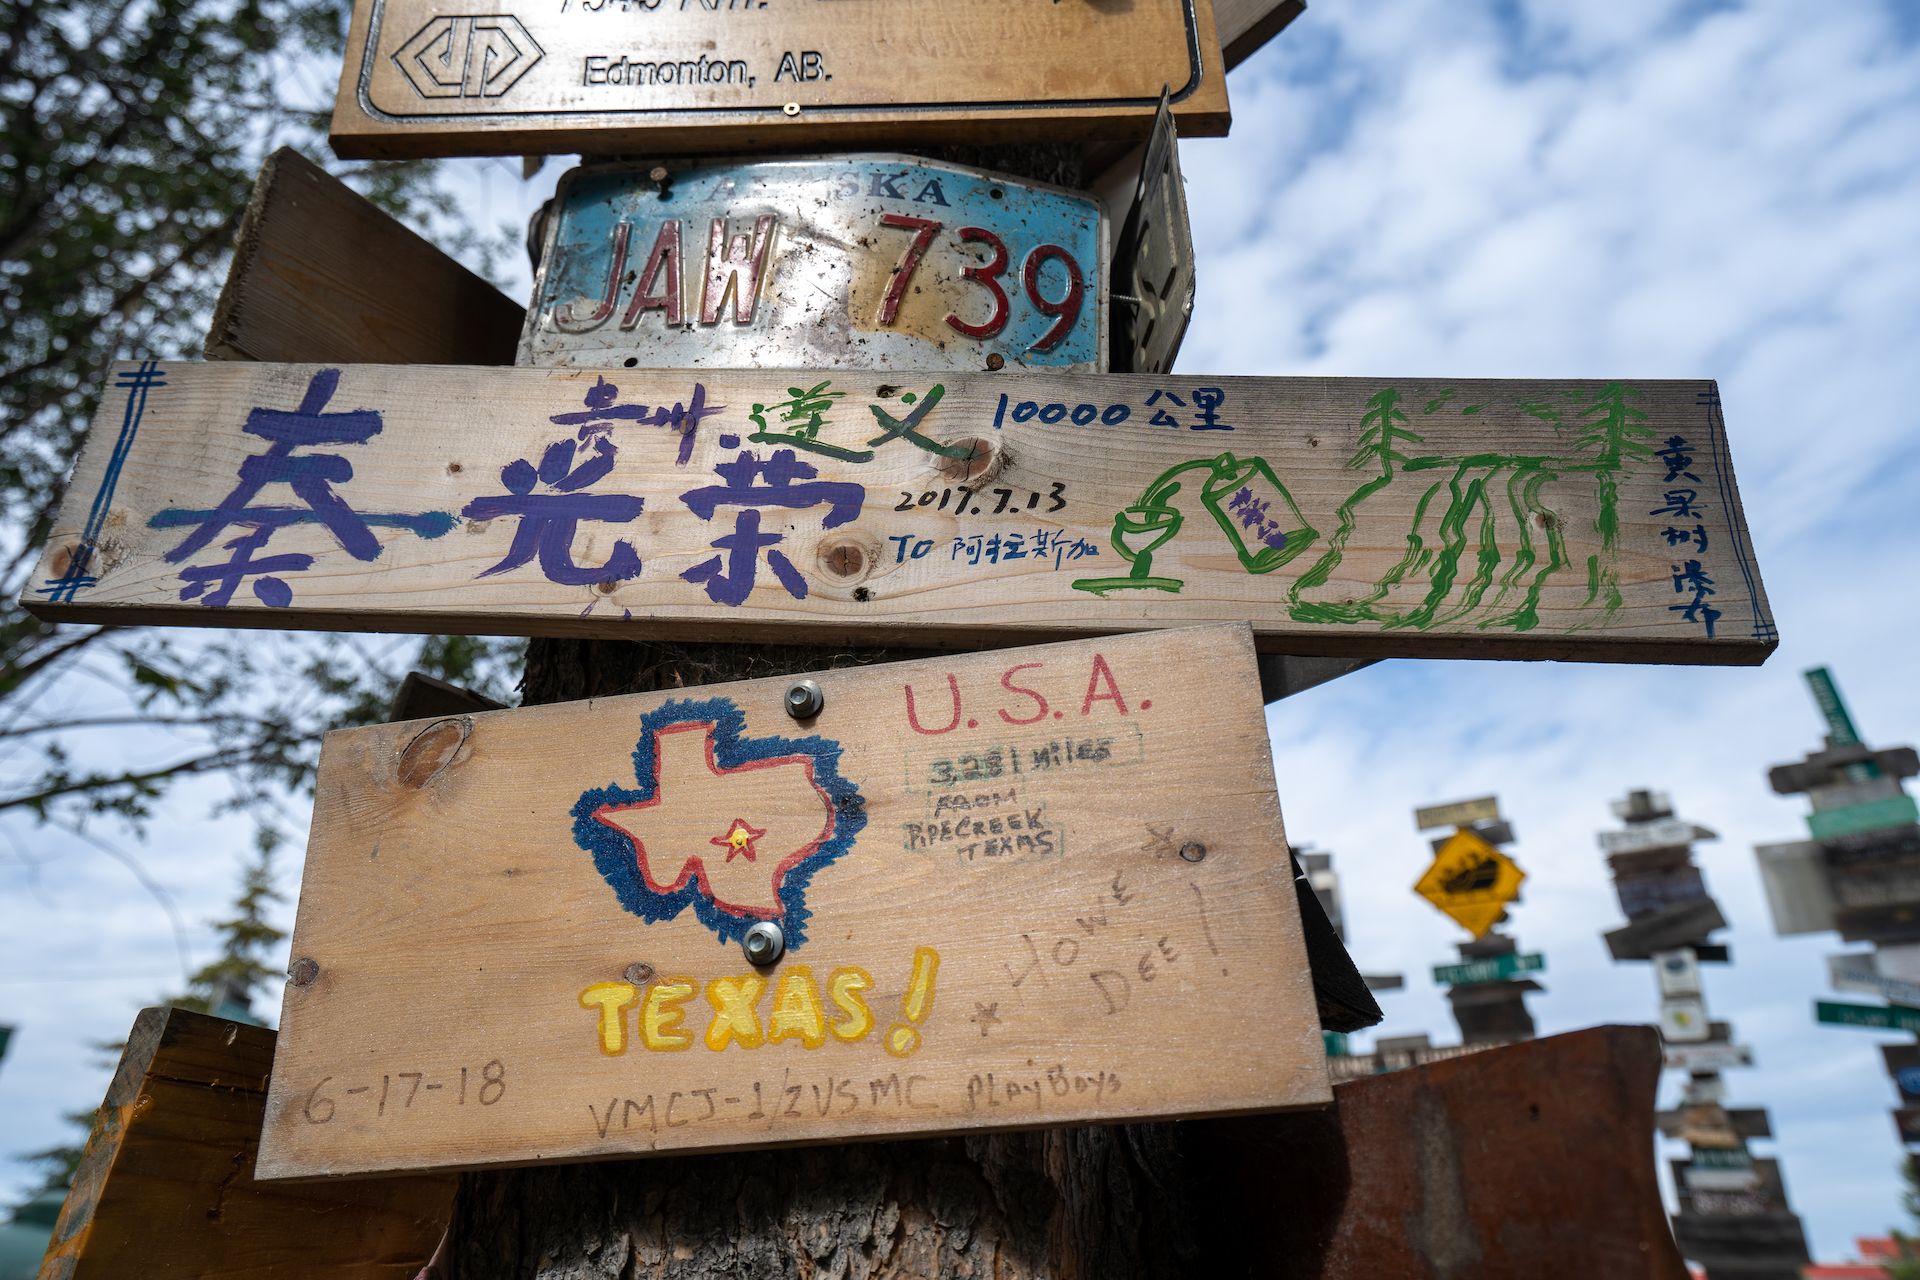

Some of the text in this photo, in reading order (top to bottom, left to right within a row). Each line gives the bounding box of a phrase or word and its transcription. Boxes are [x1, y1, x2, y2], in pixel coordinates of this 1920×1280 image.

[583, 51, 833, 88] Edmonton, AB.
[706, 170, 952, 207] ASKA
[555, 213, 1085, 354] JAW 739
[993, 387, 1235, 431] 10000 公里
[895, 481, 1068, 515] 2017.7.13
[951, 528, 1100, 571] 阿拉斯加
[904, 653, 1153, 735] U.S.A.
[304, 1059, 507, 1125] 6-17-18
